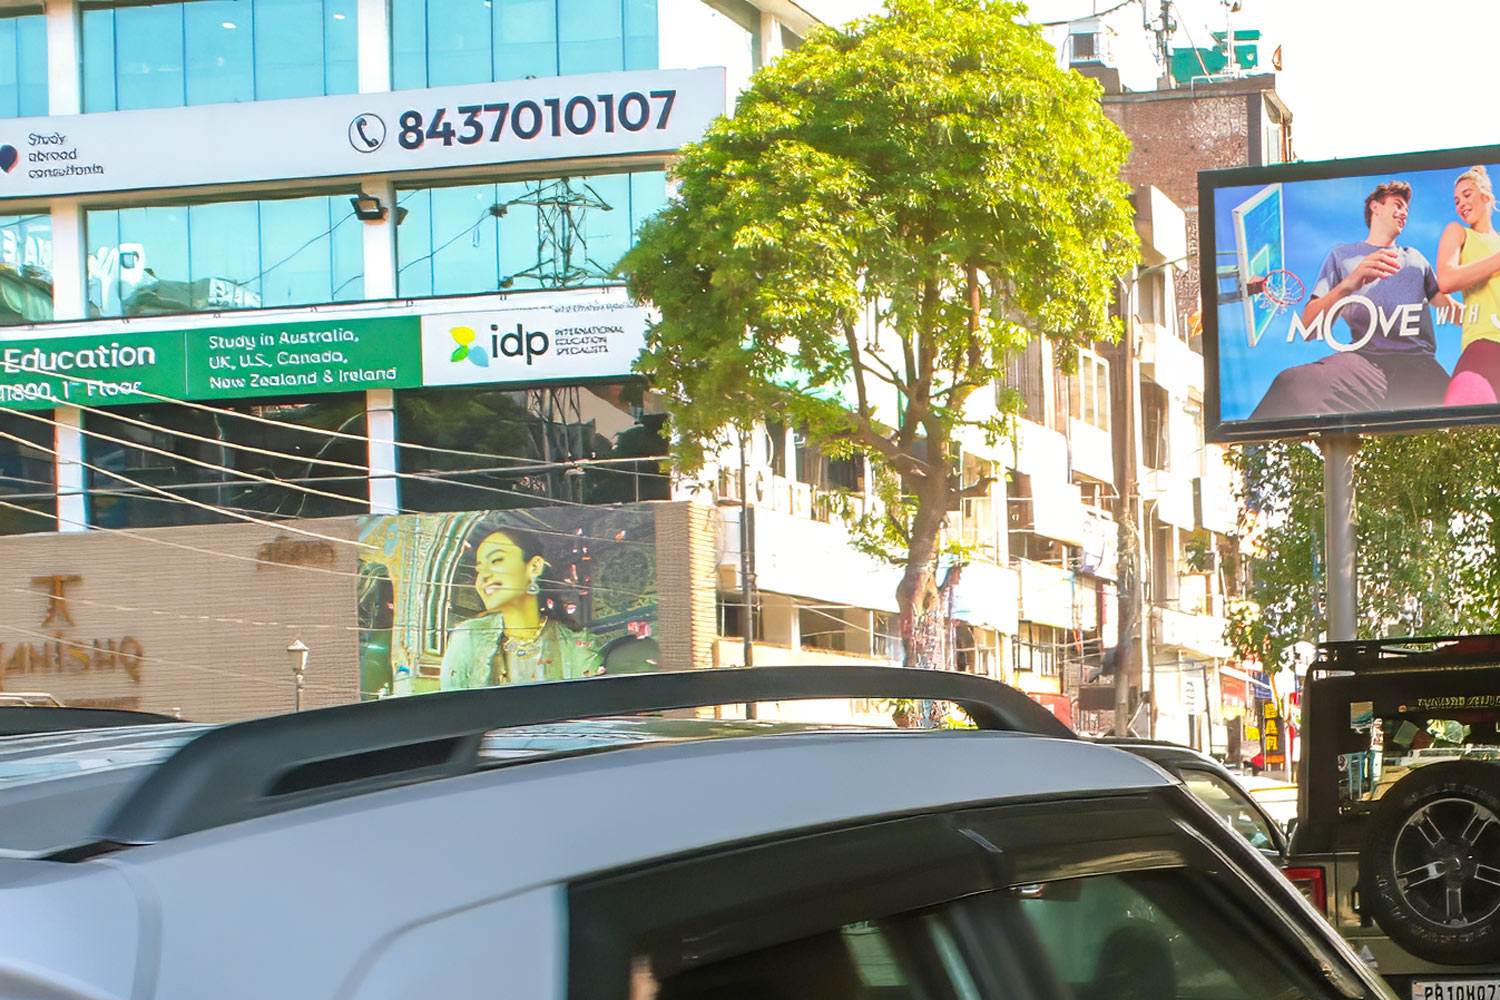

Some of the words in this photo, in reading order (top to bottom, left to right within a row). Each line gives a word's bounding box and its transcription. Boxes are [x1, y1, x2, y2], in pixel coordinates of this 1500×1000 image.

[399, 90, 676, 149] 8437010107
[28, 132, 65, 146] Study
[28, 148, 77, 162] abroad
[1286, 294, 1424, 352] MOVE
[1435, 304, 1479, 326] WITH
[209, 335, 256, 350] Study
[260, 333, 274, 347] in
[279, 328, 360, 344] Australia,
[490, 323, 549, 365] idp
[4, 343, 156, 373] Education
[277, 351, 348, 365] Canada,
[250, 372, 317, 387] Zealand
[323, 369, 334, 383] &
[339, 367, 397, 382] Ireland
